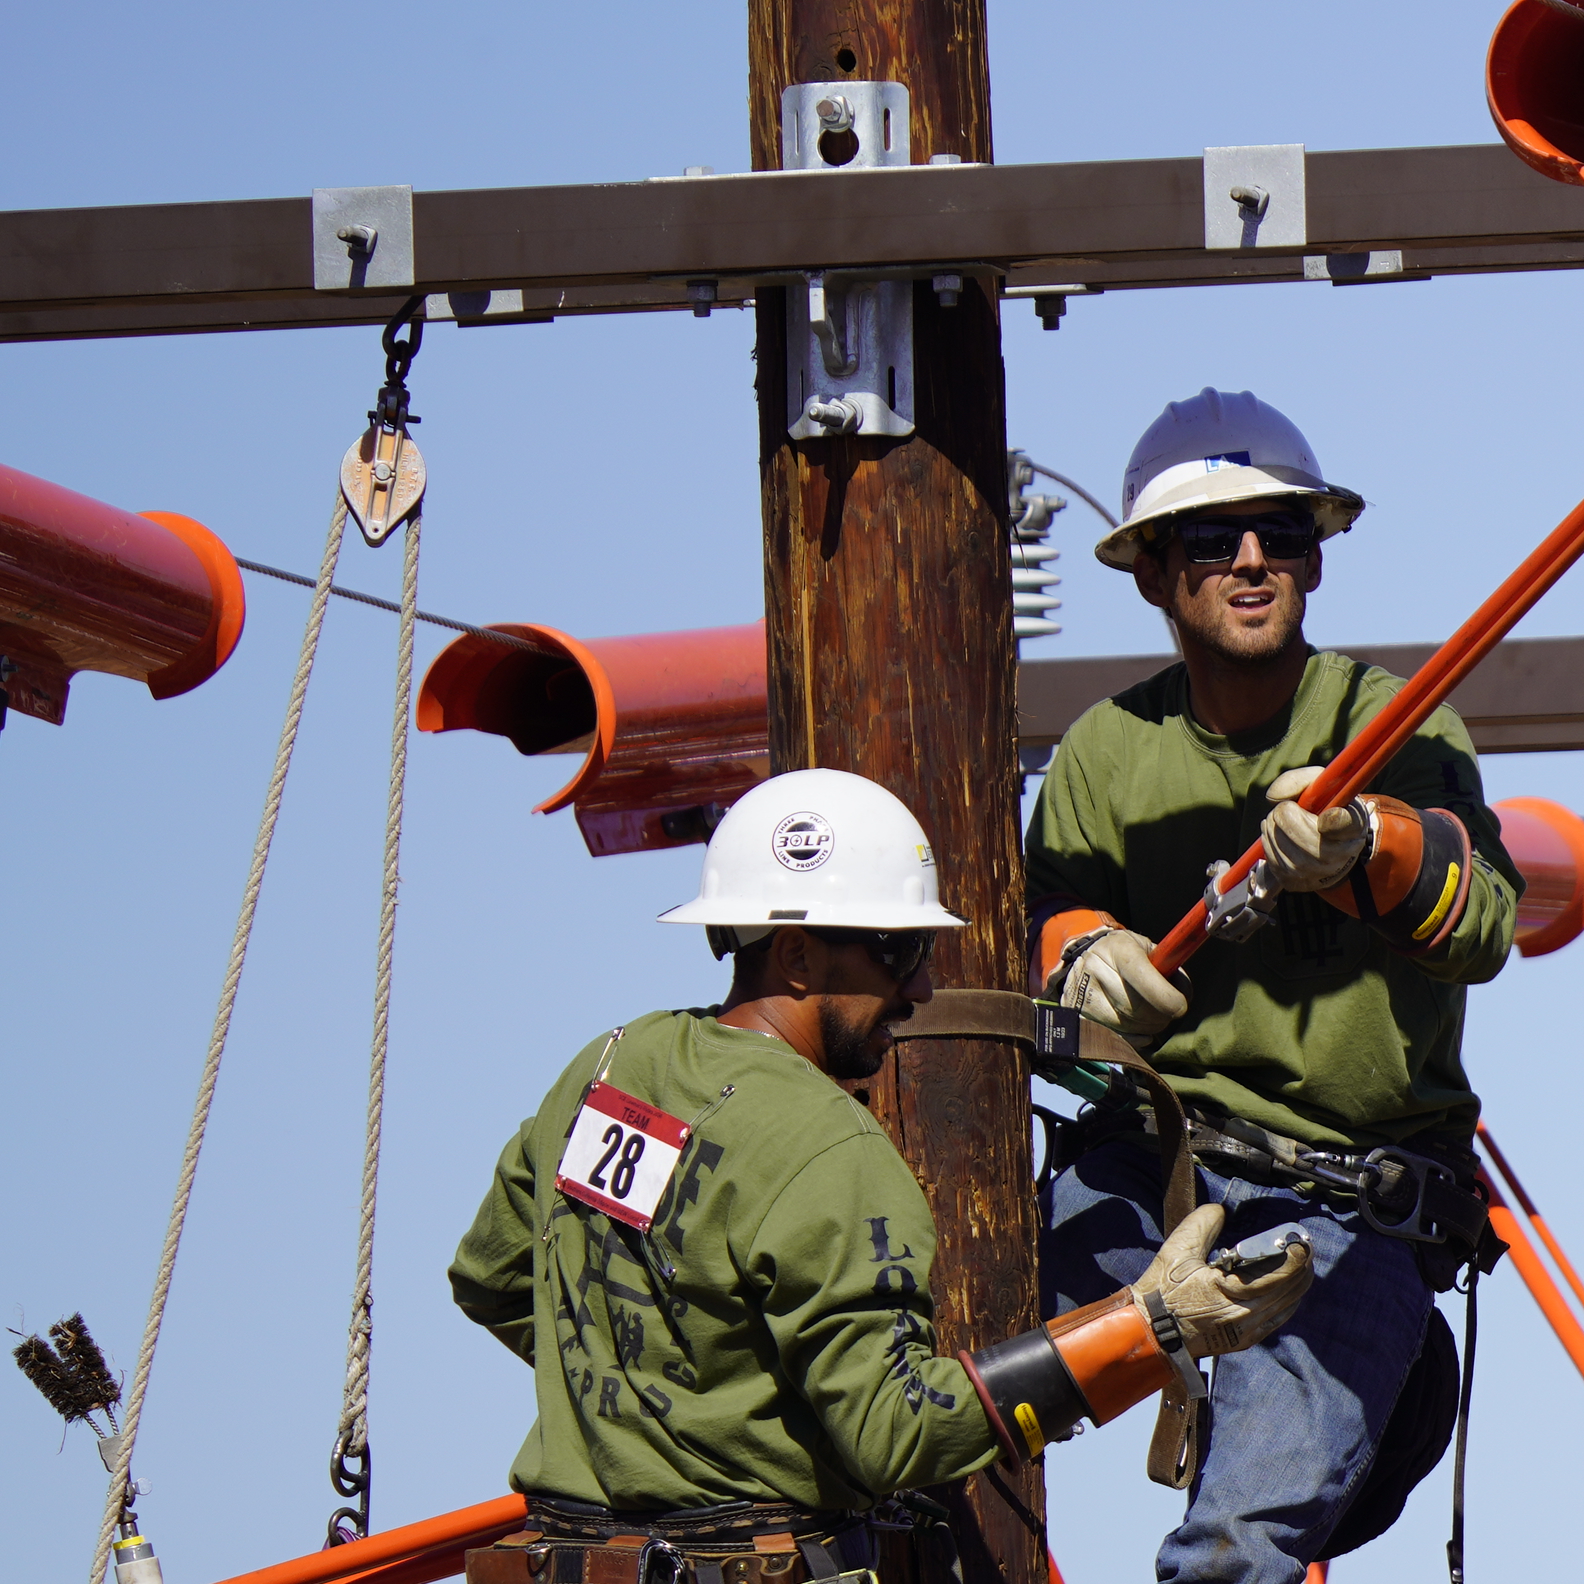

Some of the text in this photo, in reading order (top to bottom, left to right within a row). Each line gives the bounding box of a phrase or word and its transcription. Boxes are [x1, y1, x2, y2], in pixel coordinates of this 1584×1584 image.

[795, 849, 830, 869] PRODUCTS
[1075, 972, 1090, 1009] SALISBUR
[621, 1106, 651, 1130] TEAM
[587, 1123, 646, 1200] 28
